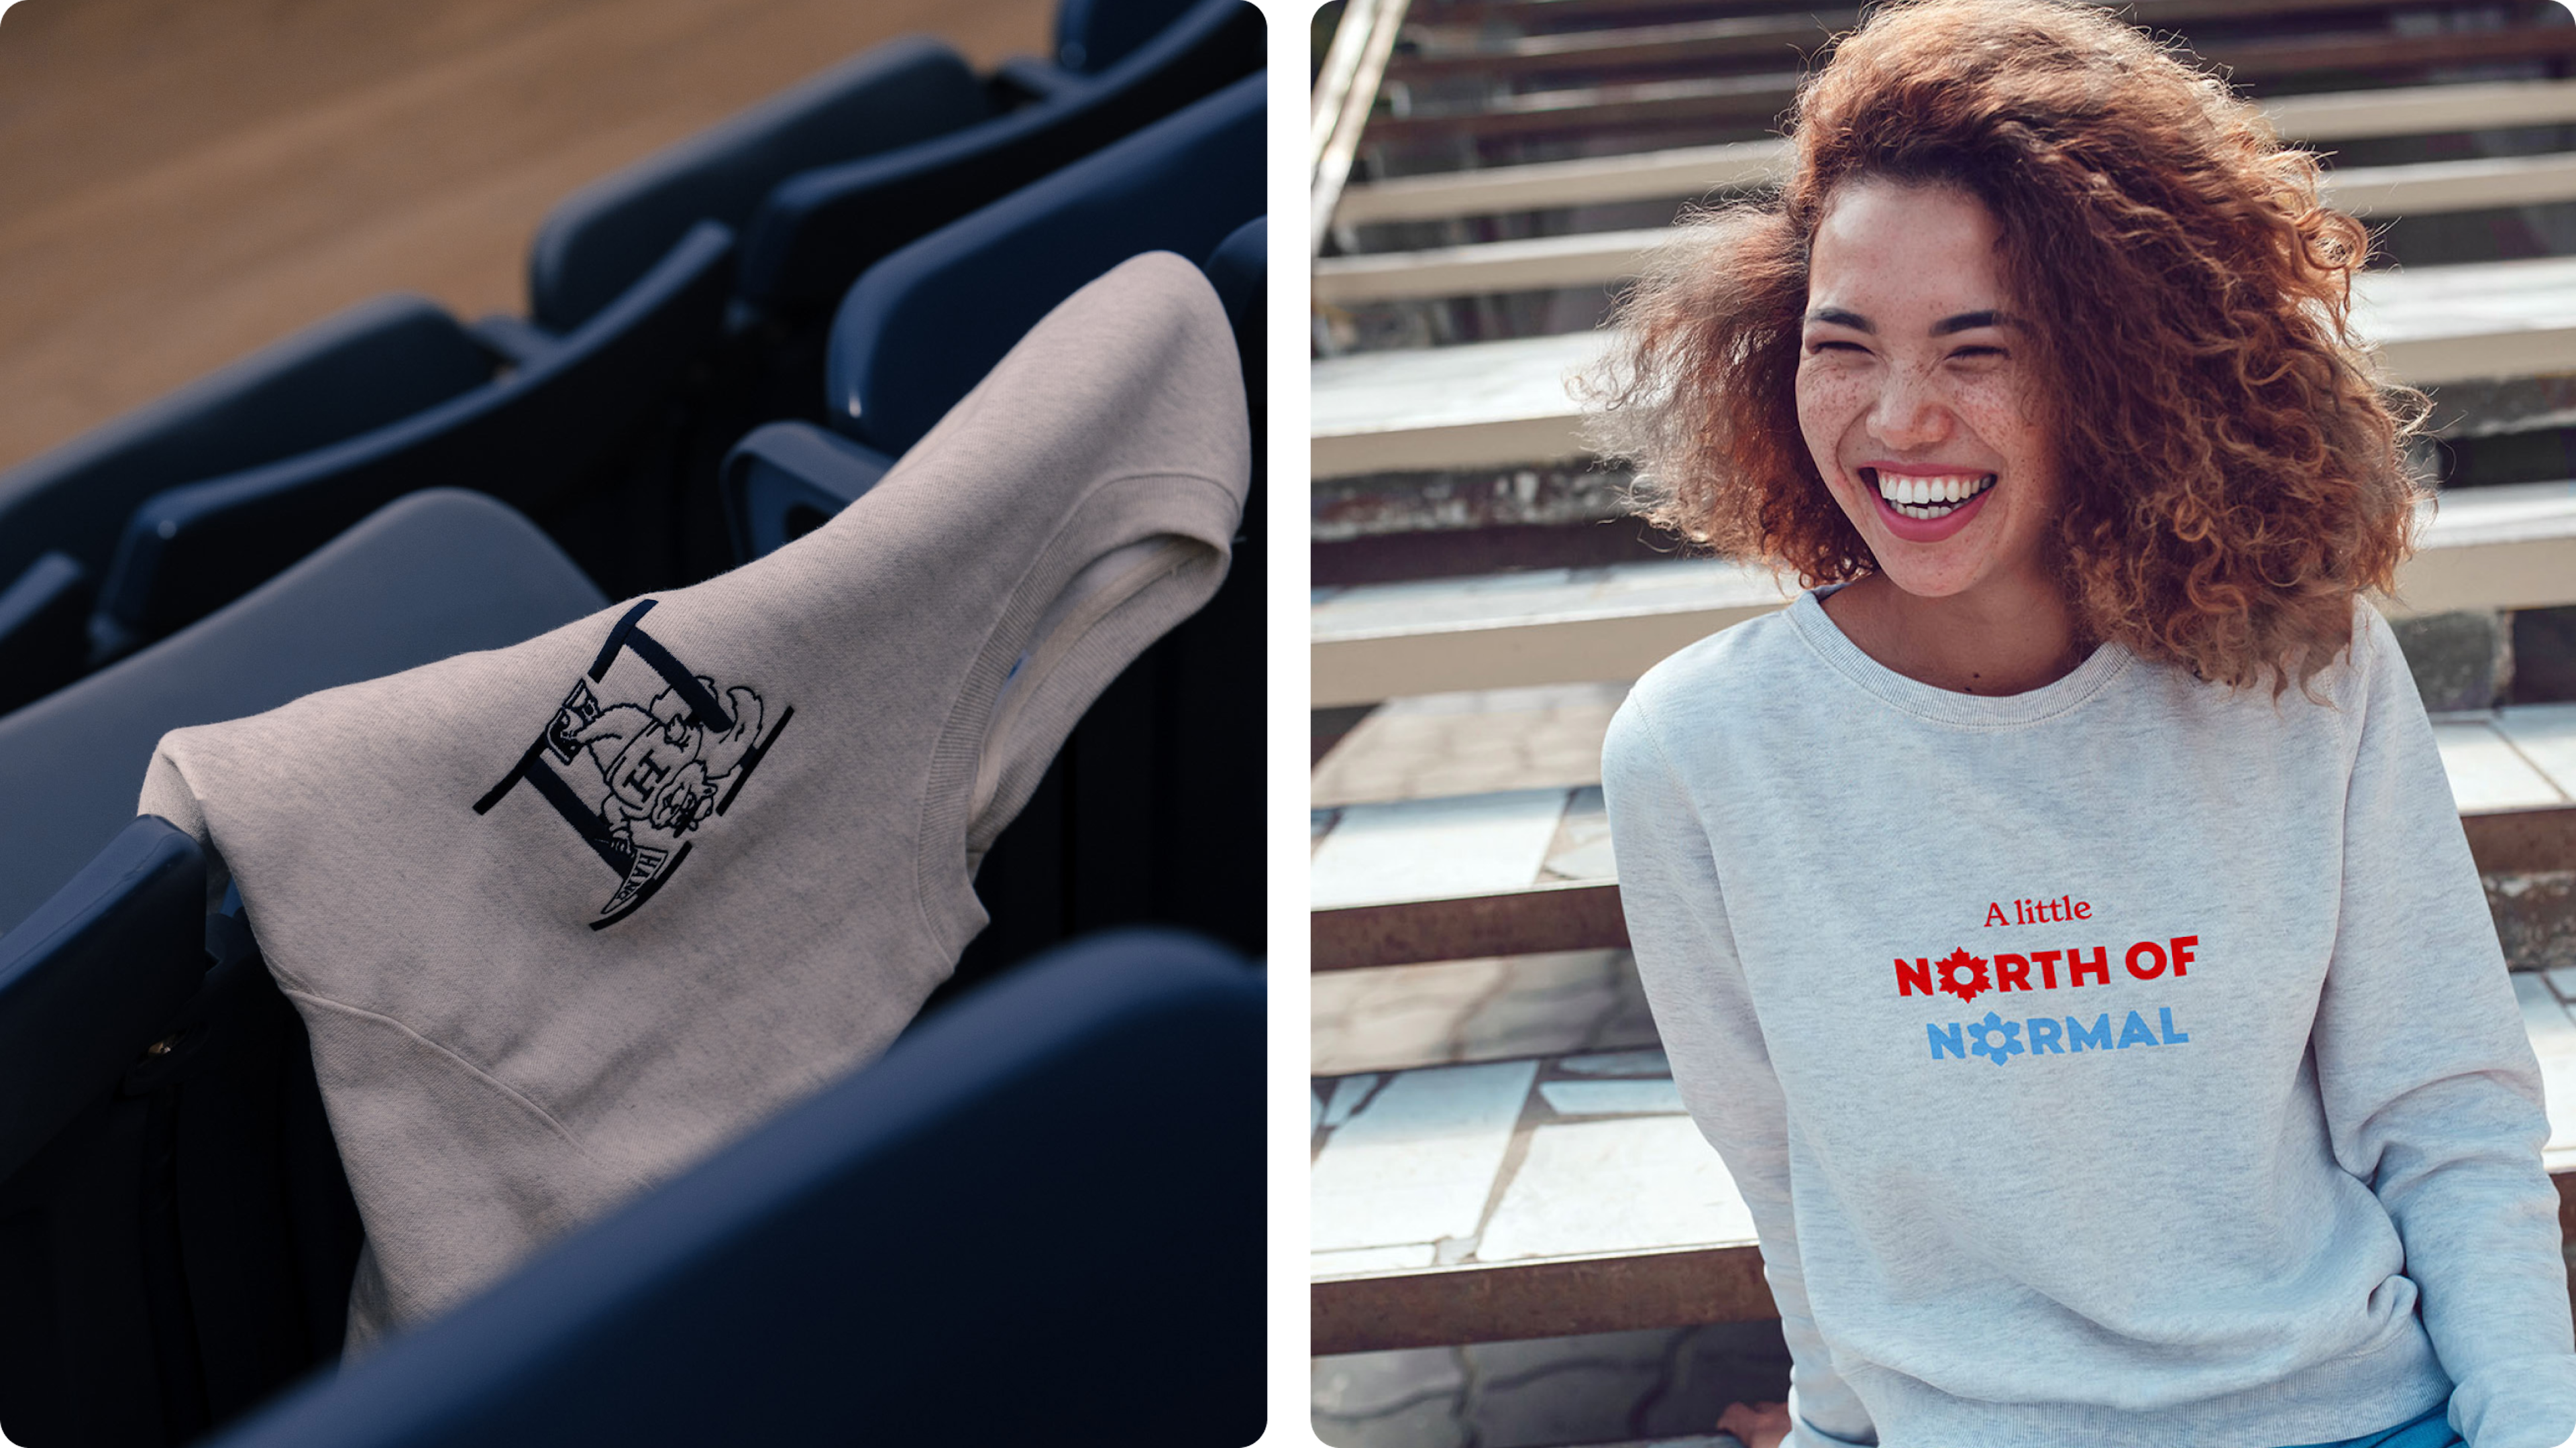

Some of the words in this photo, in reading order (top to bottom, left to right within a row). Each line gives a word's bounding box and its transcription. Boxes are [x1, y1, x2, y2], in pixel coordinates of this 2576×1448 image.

[623, 749, 669, 803] H
[1984, 902, 2010, 927] A
[2015, 895, 2093, 926] little
[1894, 946, 2111, 1004] NORTH
[2125, 935, 2199, 981] OF
[1927, 1007, 2190, 1066] NORMAL
